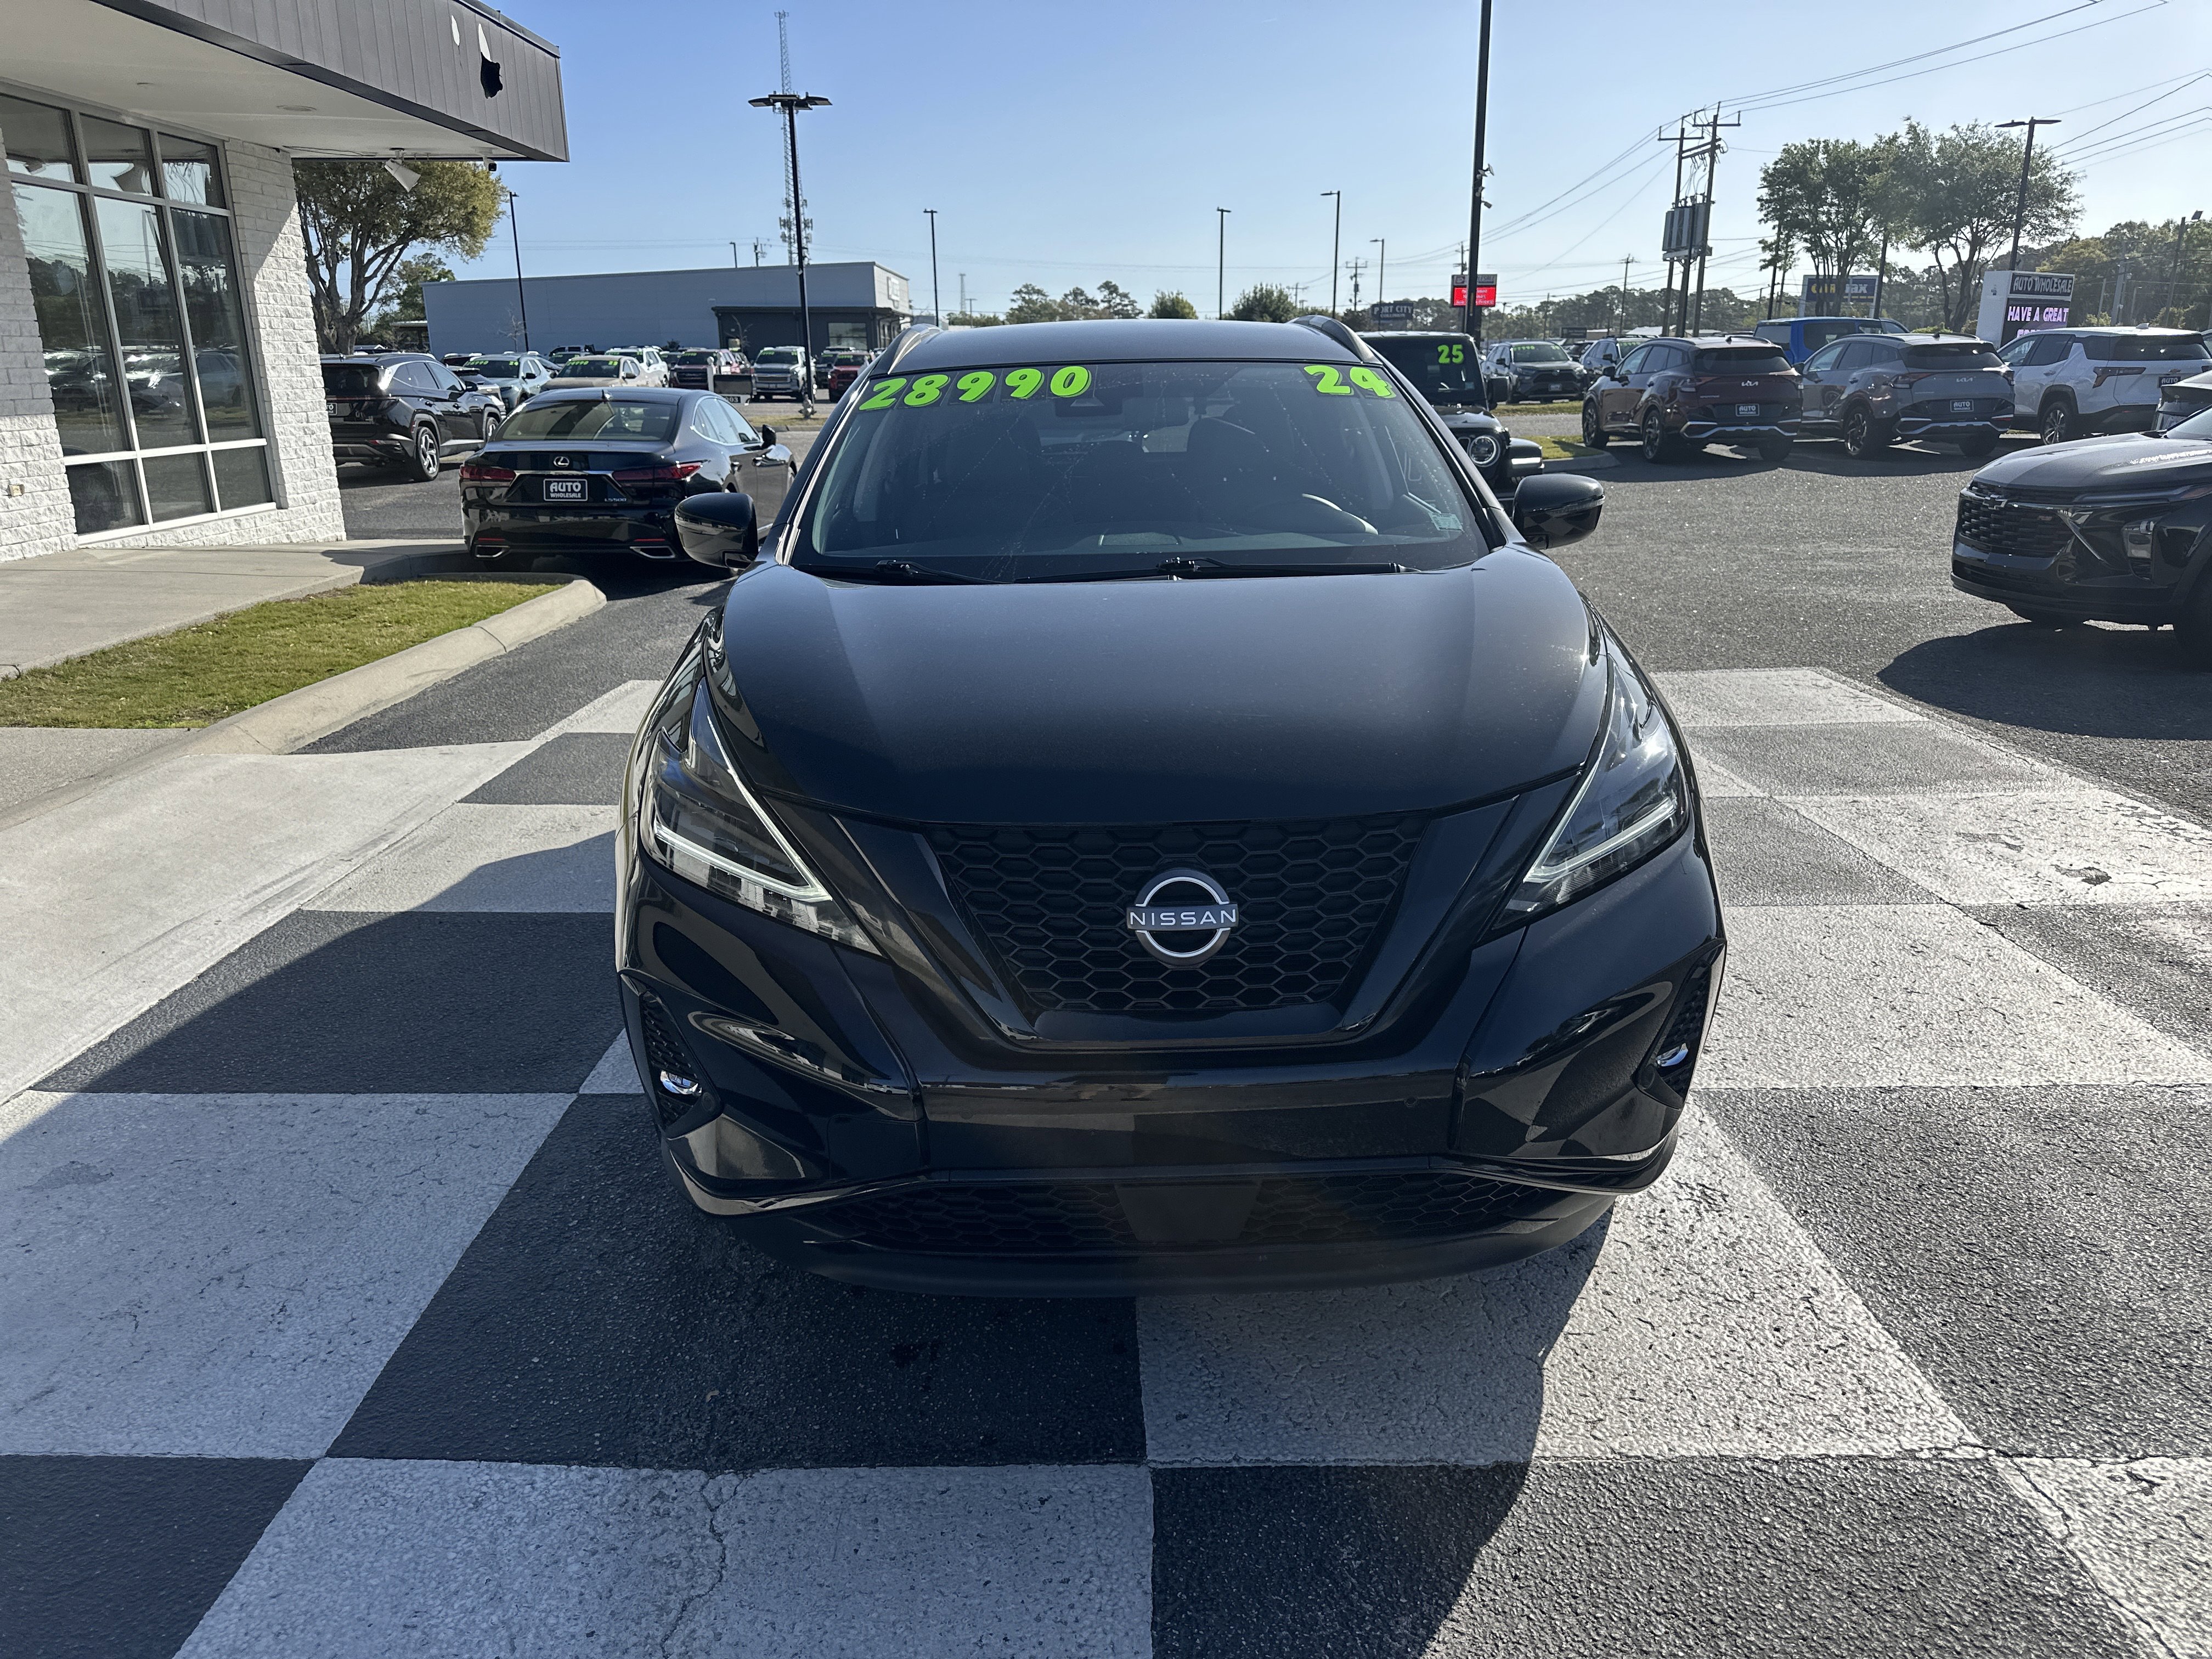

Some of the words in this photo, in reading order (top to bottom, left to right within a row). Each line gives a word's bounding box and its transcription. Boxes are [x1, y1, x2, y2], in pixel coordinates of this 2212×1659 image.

[2013, 276, 2033, 291] AUTO
[2034, 276, 2073, 294] WHOLESALE
[1395, 305, 1413, 313] CITY
[2007, 306, 2032, 321] HAVE
[2033, 307, 2040, 321] A
[2042, 307, 2069, 322] GREAT
[1437, 344, 1464, 364] 25
[859, 365, 1092, 411] 28990
[1304, 365, 1393, 397] 24
[550, 482, 582, 493] AUTO
[1130, 909, 1237, 926] NISSAN
